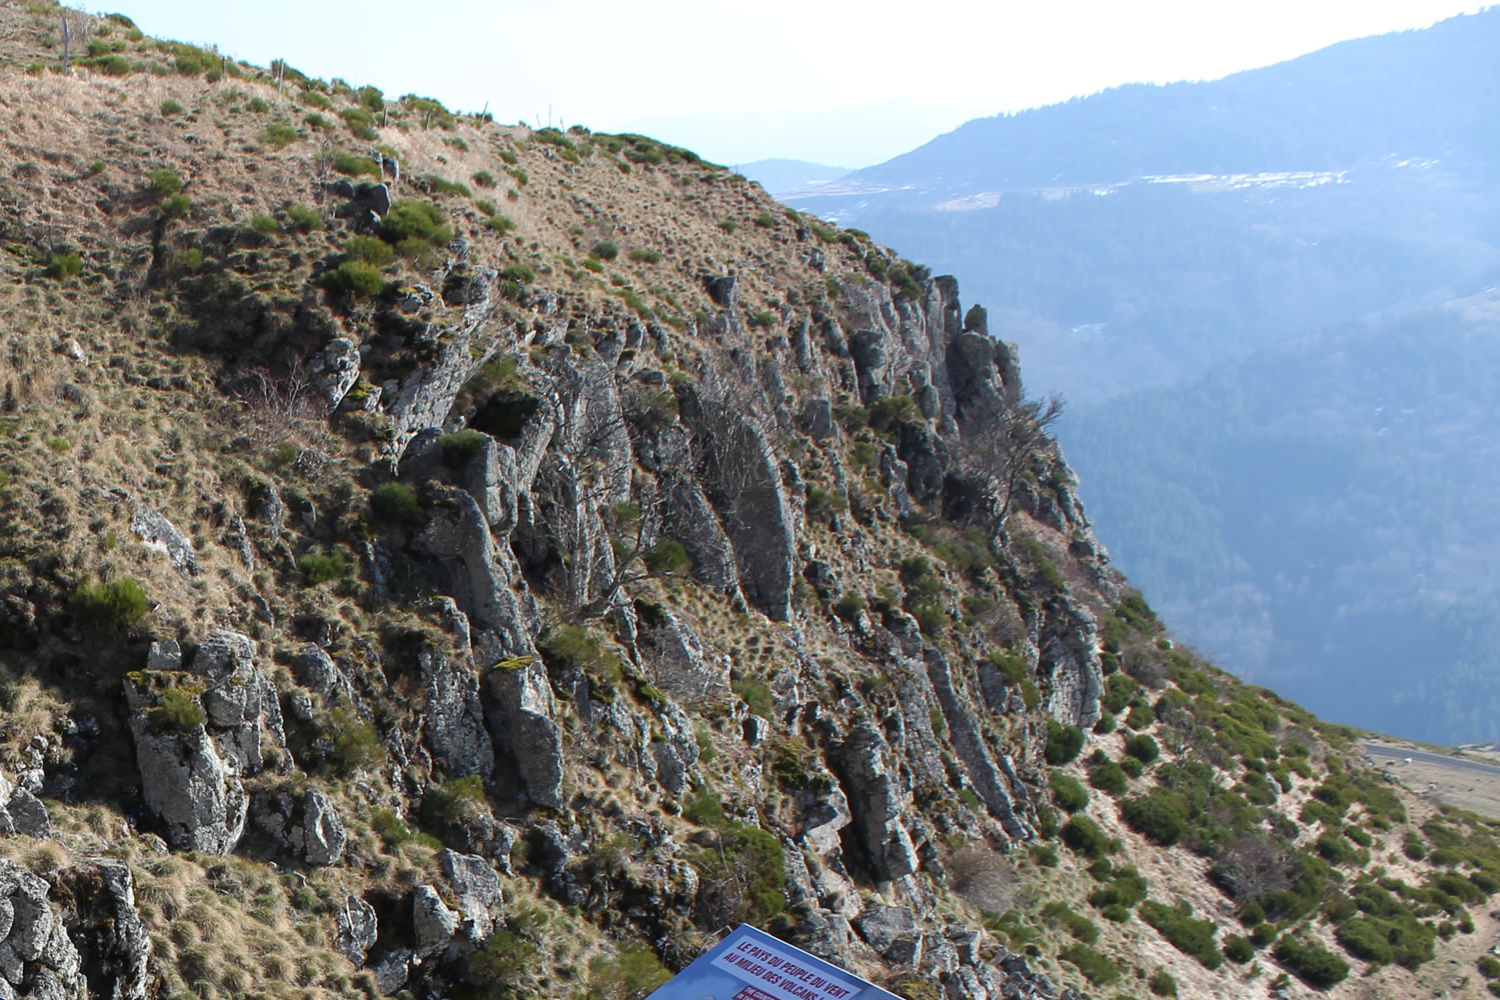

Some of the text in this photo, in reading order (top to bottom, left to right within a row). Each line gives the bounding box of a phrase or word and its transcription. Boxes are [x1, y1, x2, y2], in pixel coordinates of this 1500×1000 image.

[723, 952, 740, 963] AU
[734, 958, 767, 976] MILIEU
[762, 971, 782, 984] DES
[736, 941, 850, 999] LE PAYS DU PEUPLE DU VENT
